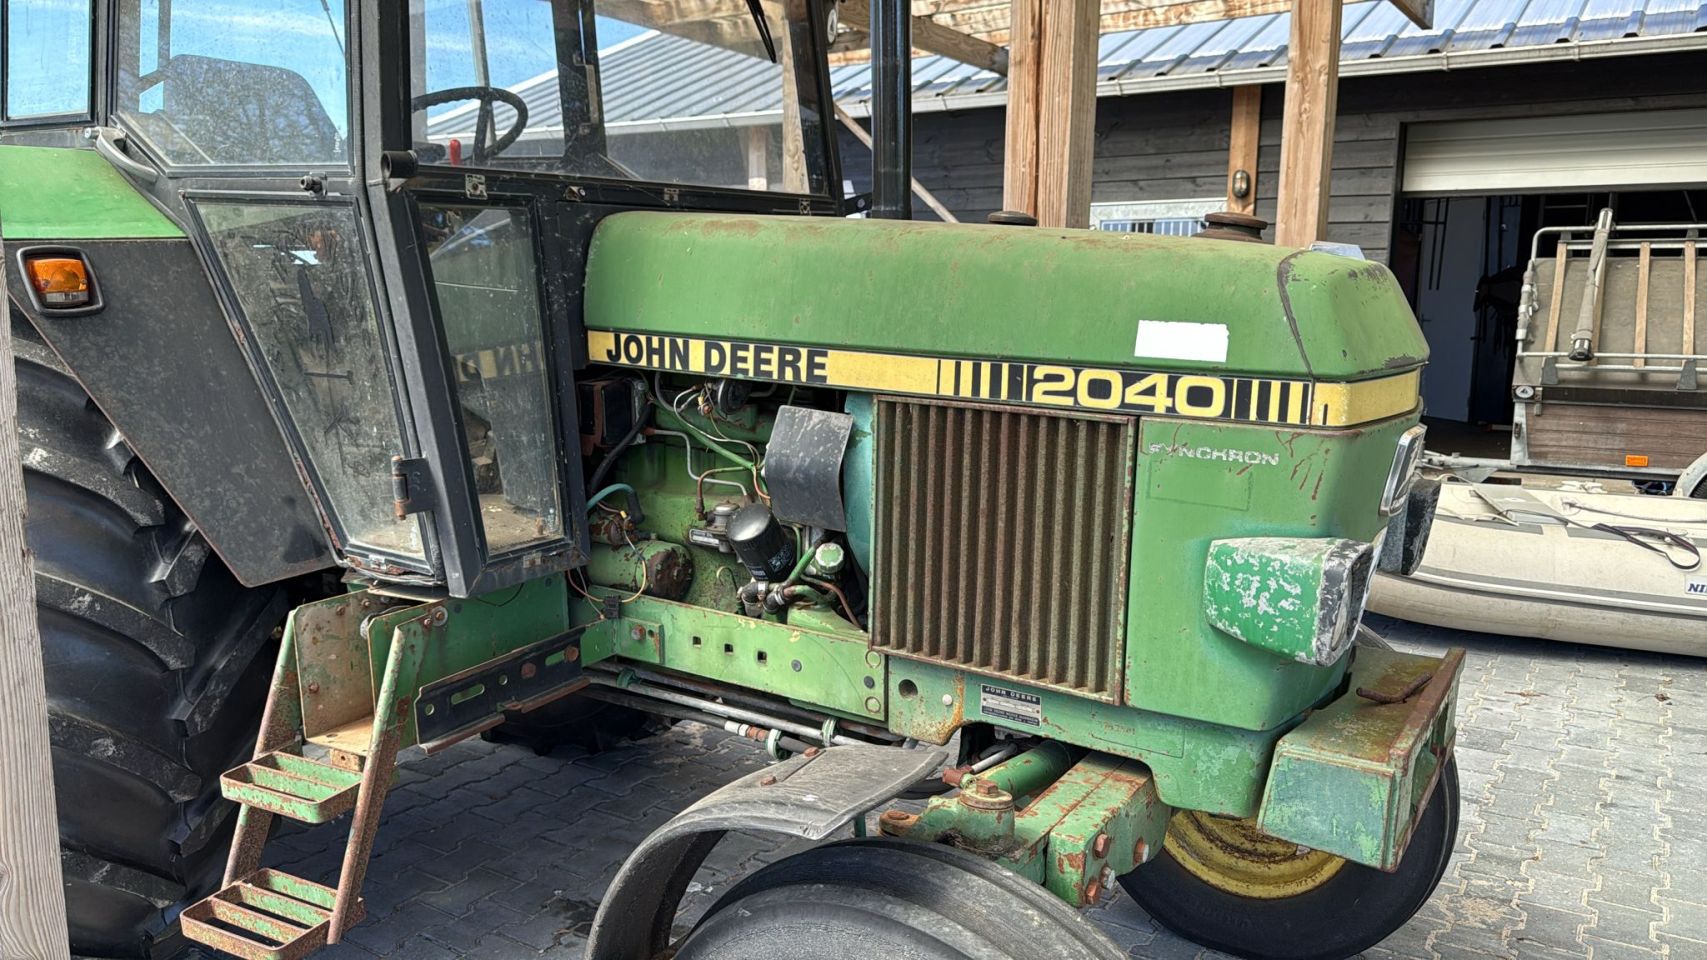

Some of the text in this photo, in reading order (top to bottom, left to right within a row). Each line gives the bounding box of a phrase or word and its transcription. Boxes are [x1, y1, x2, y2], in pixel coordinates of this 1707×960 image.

[606, 333, 829, 384] JOHN DEERE
[1033, 365, 1226, 418] 2040
[1688, 583, 1707, 593] NI
